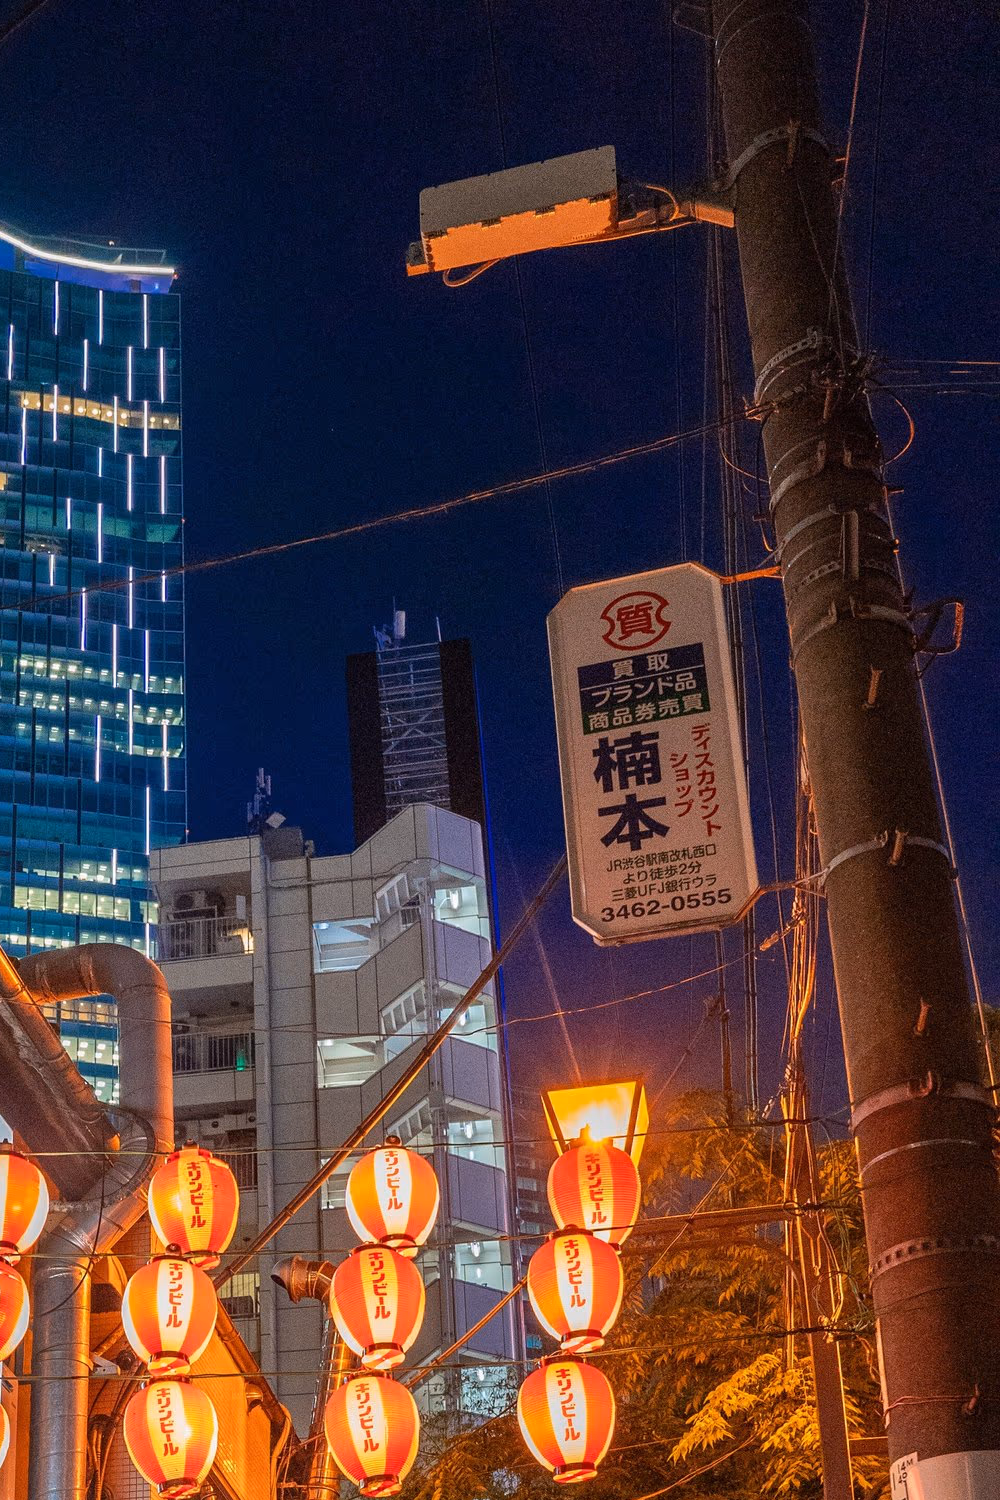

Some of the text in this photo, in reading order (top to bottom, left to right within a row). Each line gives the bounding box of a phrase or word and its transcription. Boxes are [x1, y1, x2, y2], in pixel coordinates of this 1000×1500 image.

[616, 602, 656, 641] 質
[591, 672, 697, 708] ブランド品
[612, 653, 670, 680] 買取
[588, 693, 705, 732] 商品券売買
[592, 731, 670, 851] 楠本
[670, 753, 694, 817] ショップ
[691, 723, 722, 837] ディスカウント
[606, 843, 717, 872] JR渋谷駅南改札西口
[611, 874, 717, 902] 三菱UFJ銀行ウラ
[623, 861, 702, 885] より徒歩2分
[601, 888, 732, 922] 3462-0555
[186, 1161, 205, 1228] キリンビール
[384, 1149, 402, 1211] キリンビール
[585, 1153, 607, 1224] キリンビール
[167, 1262, 183, 1328] キリンビール
[368, 1252, 391, 1320] キリンビール
[563, 1240, 586, 1308] キリンビール
[156, 1387, 179, 1457] キリンビール
[356, 1383, 380, 1453] キリンビール
[556, 1368, 580, 1442] キリンビール
